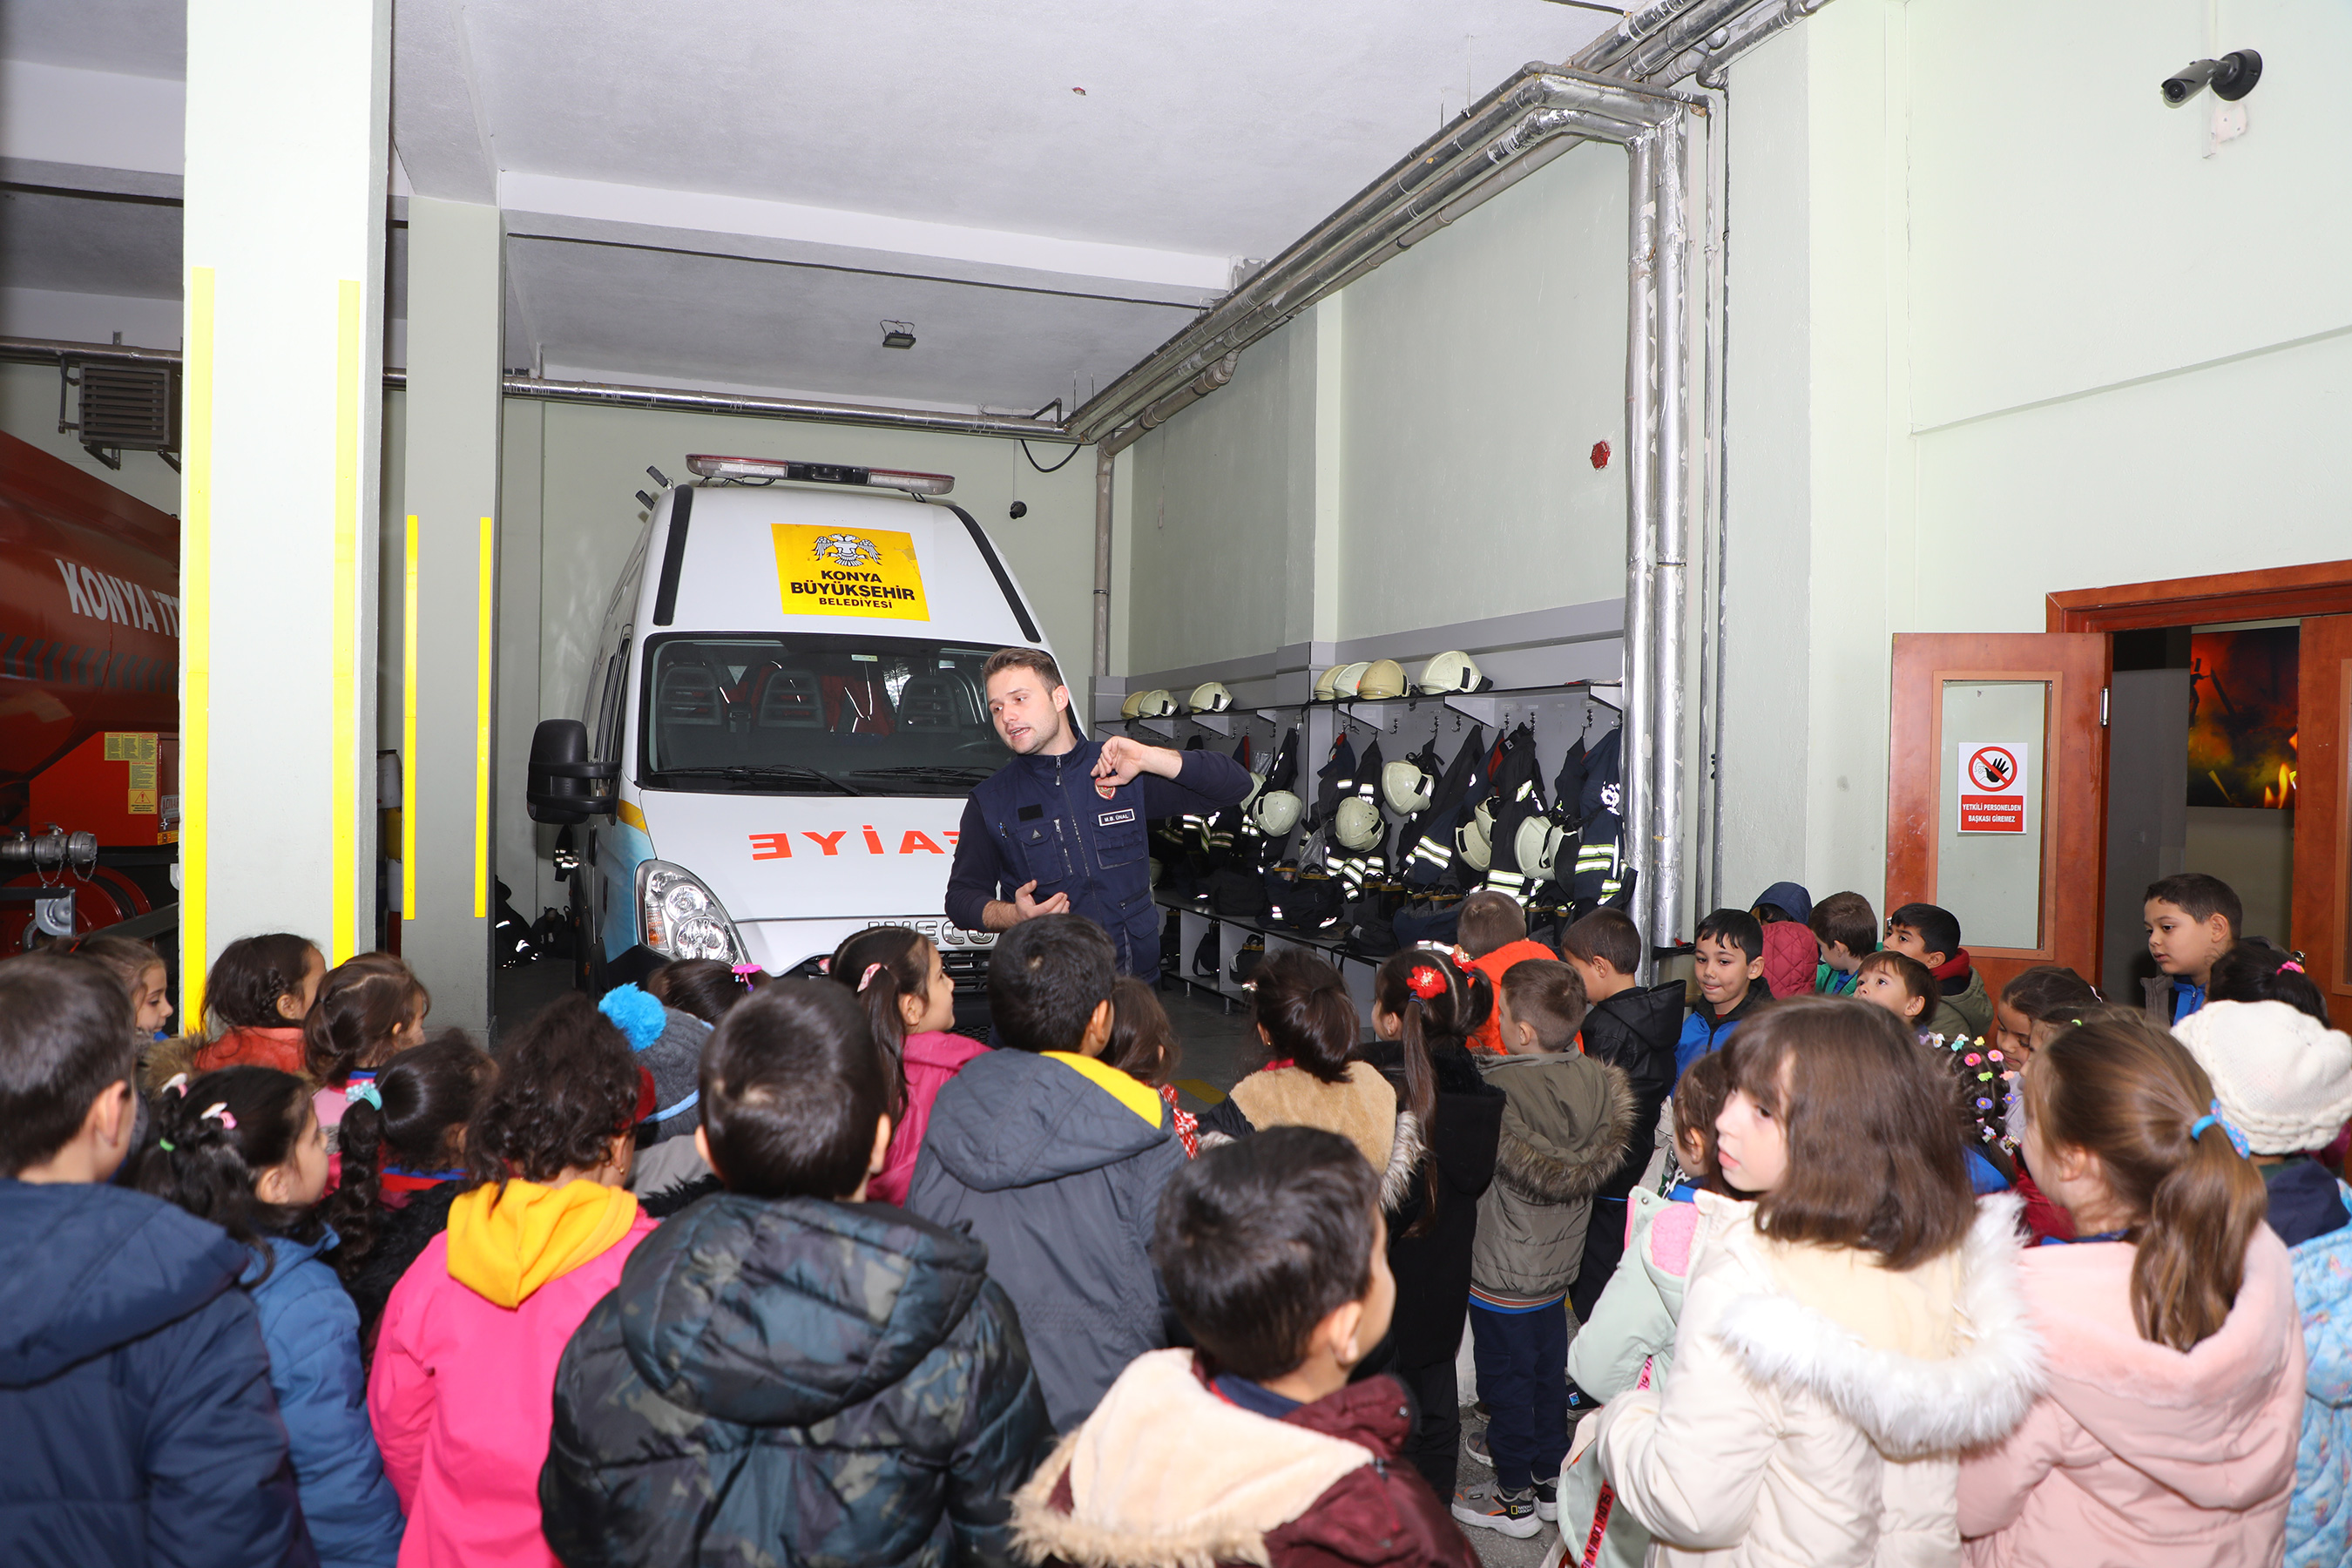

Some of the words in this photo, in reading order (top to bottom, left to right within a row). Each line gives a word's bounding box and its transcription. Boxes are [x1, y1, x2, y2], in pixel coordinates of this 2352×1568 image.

[821, 571, 882, 583] KONYA
[55, 558, 159, 633] KONYA
[791, 580, 916, 601] BÜYÜKŞEHİR
[820, 598, 893, 609] BELEDİYESİ
[1963, 802, 1984, 811] YETKİLİ
[1991, 814, 2016, 823] GİREMEZ
[868, 921, 995, 945] ECO
